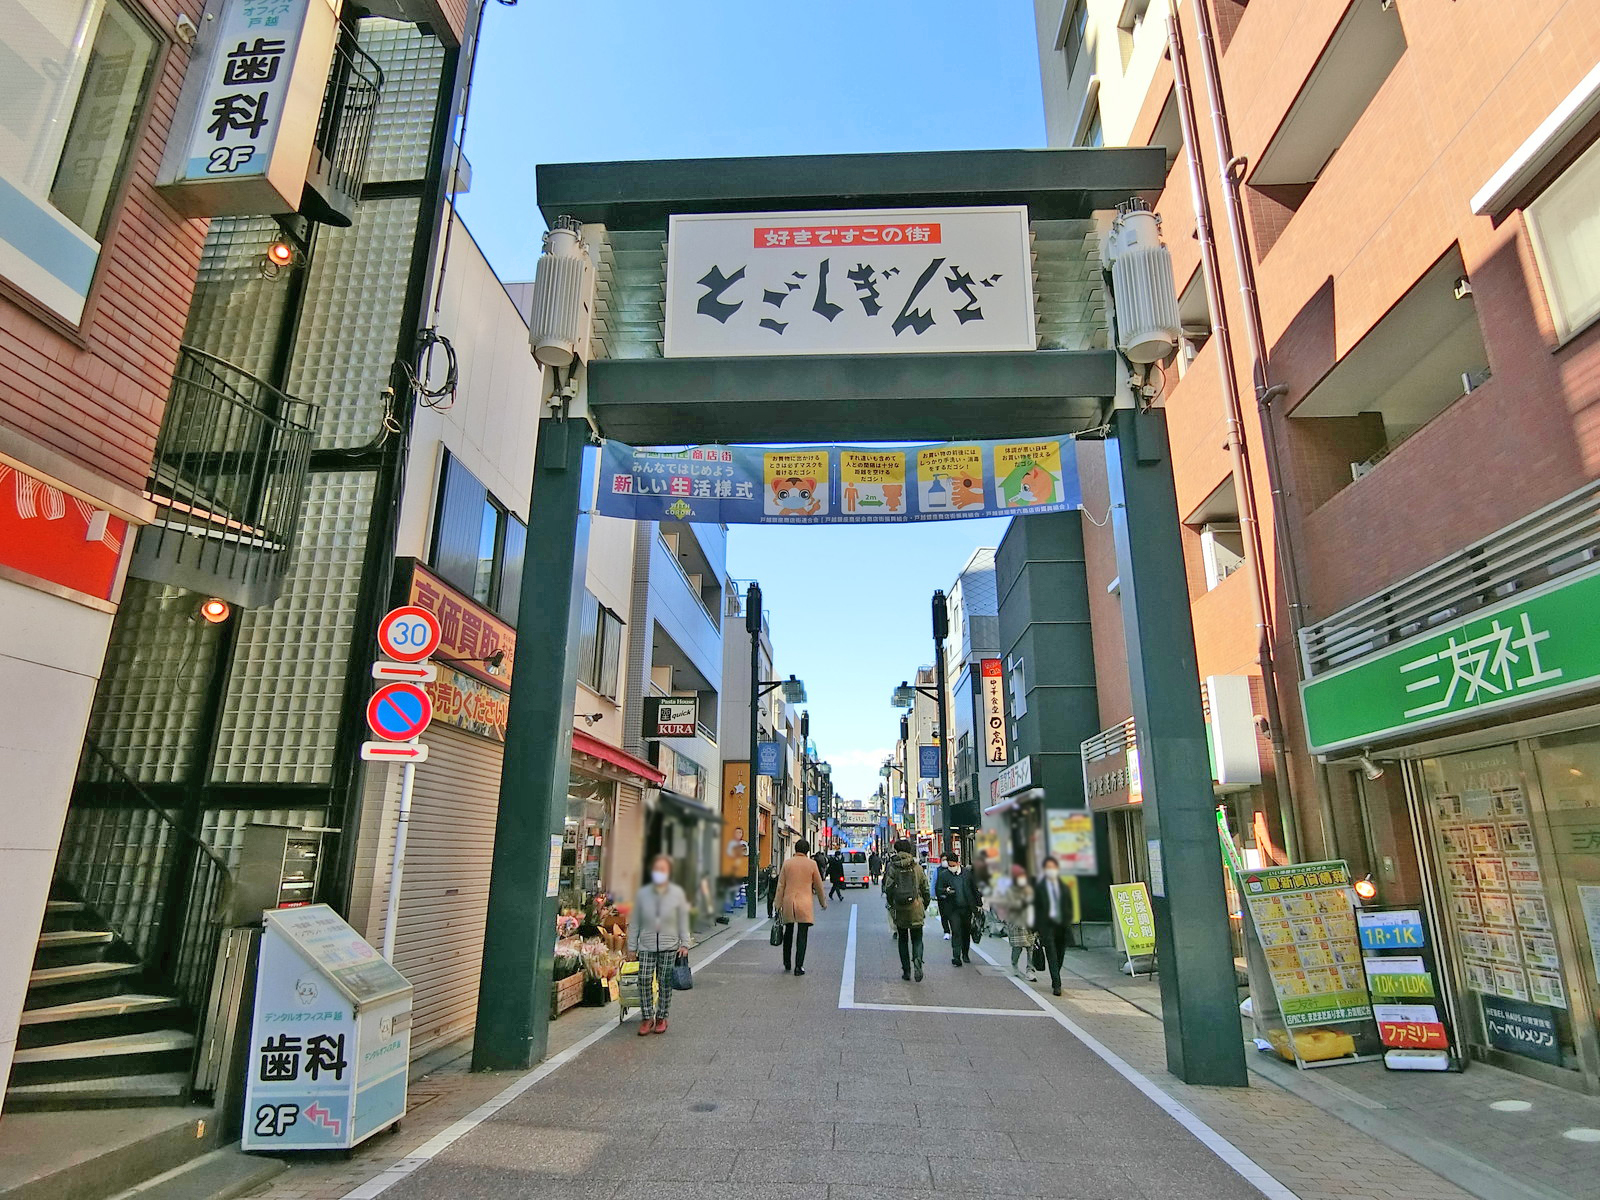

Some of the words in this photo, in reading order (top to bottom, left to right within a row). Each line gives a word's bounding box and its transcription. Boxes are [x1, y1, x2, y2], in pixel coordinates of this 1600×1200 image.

[243, 5, 289, 16] オフィス
[248, 16, 279, 28] 戸越
[207, 38, 285, 141] 歯科
[206, 146, 255, 173] 2F
[764, 226, 930, 247] 好きですこの街
[697, 257, 1003, 337] とごしぎんざ
[922, 450, 977, 459] お買い物の前後には
[1002, 453, 1051, 461] お買い物を控える
[1004, 445, 1048, 454] 体調が悪い日は
[632, 462, 734, 477] みんなではじめよう
[919, 457, 979, 466] しっかり手洗い・消毒
[614, 474, 753, 498] 新しい生活様式
[665, 509, 696, 517] CORONA
[393, 622, 427, 646] 30
[1400, 612, 1562, 718] 三友社
[658, 725, 693, 734] KURA
[990, 716, 1006, 763] 日高屋
[1267, 870, 1346, 891] 最新賃貸情報
[1117, 891, 1138, 938] 処方せん
[1132, 890, 1153, 938] 保険調剤
[264, 1011, 343, 1022] デンタルオフィス戸越
[1385, 1025, 1439, 1043] ファミリー
[1489, 1020, 1553, 1046] ヘーベルメゾン
[261, 1033, 347, 1081] 歯科
[254, 1104, 299, 1136] 2F
